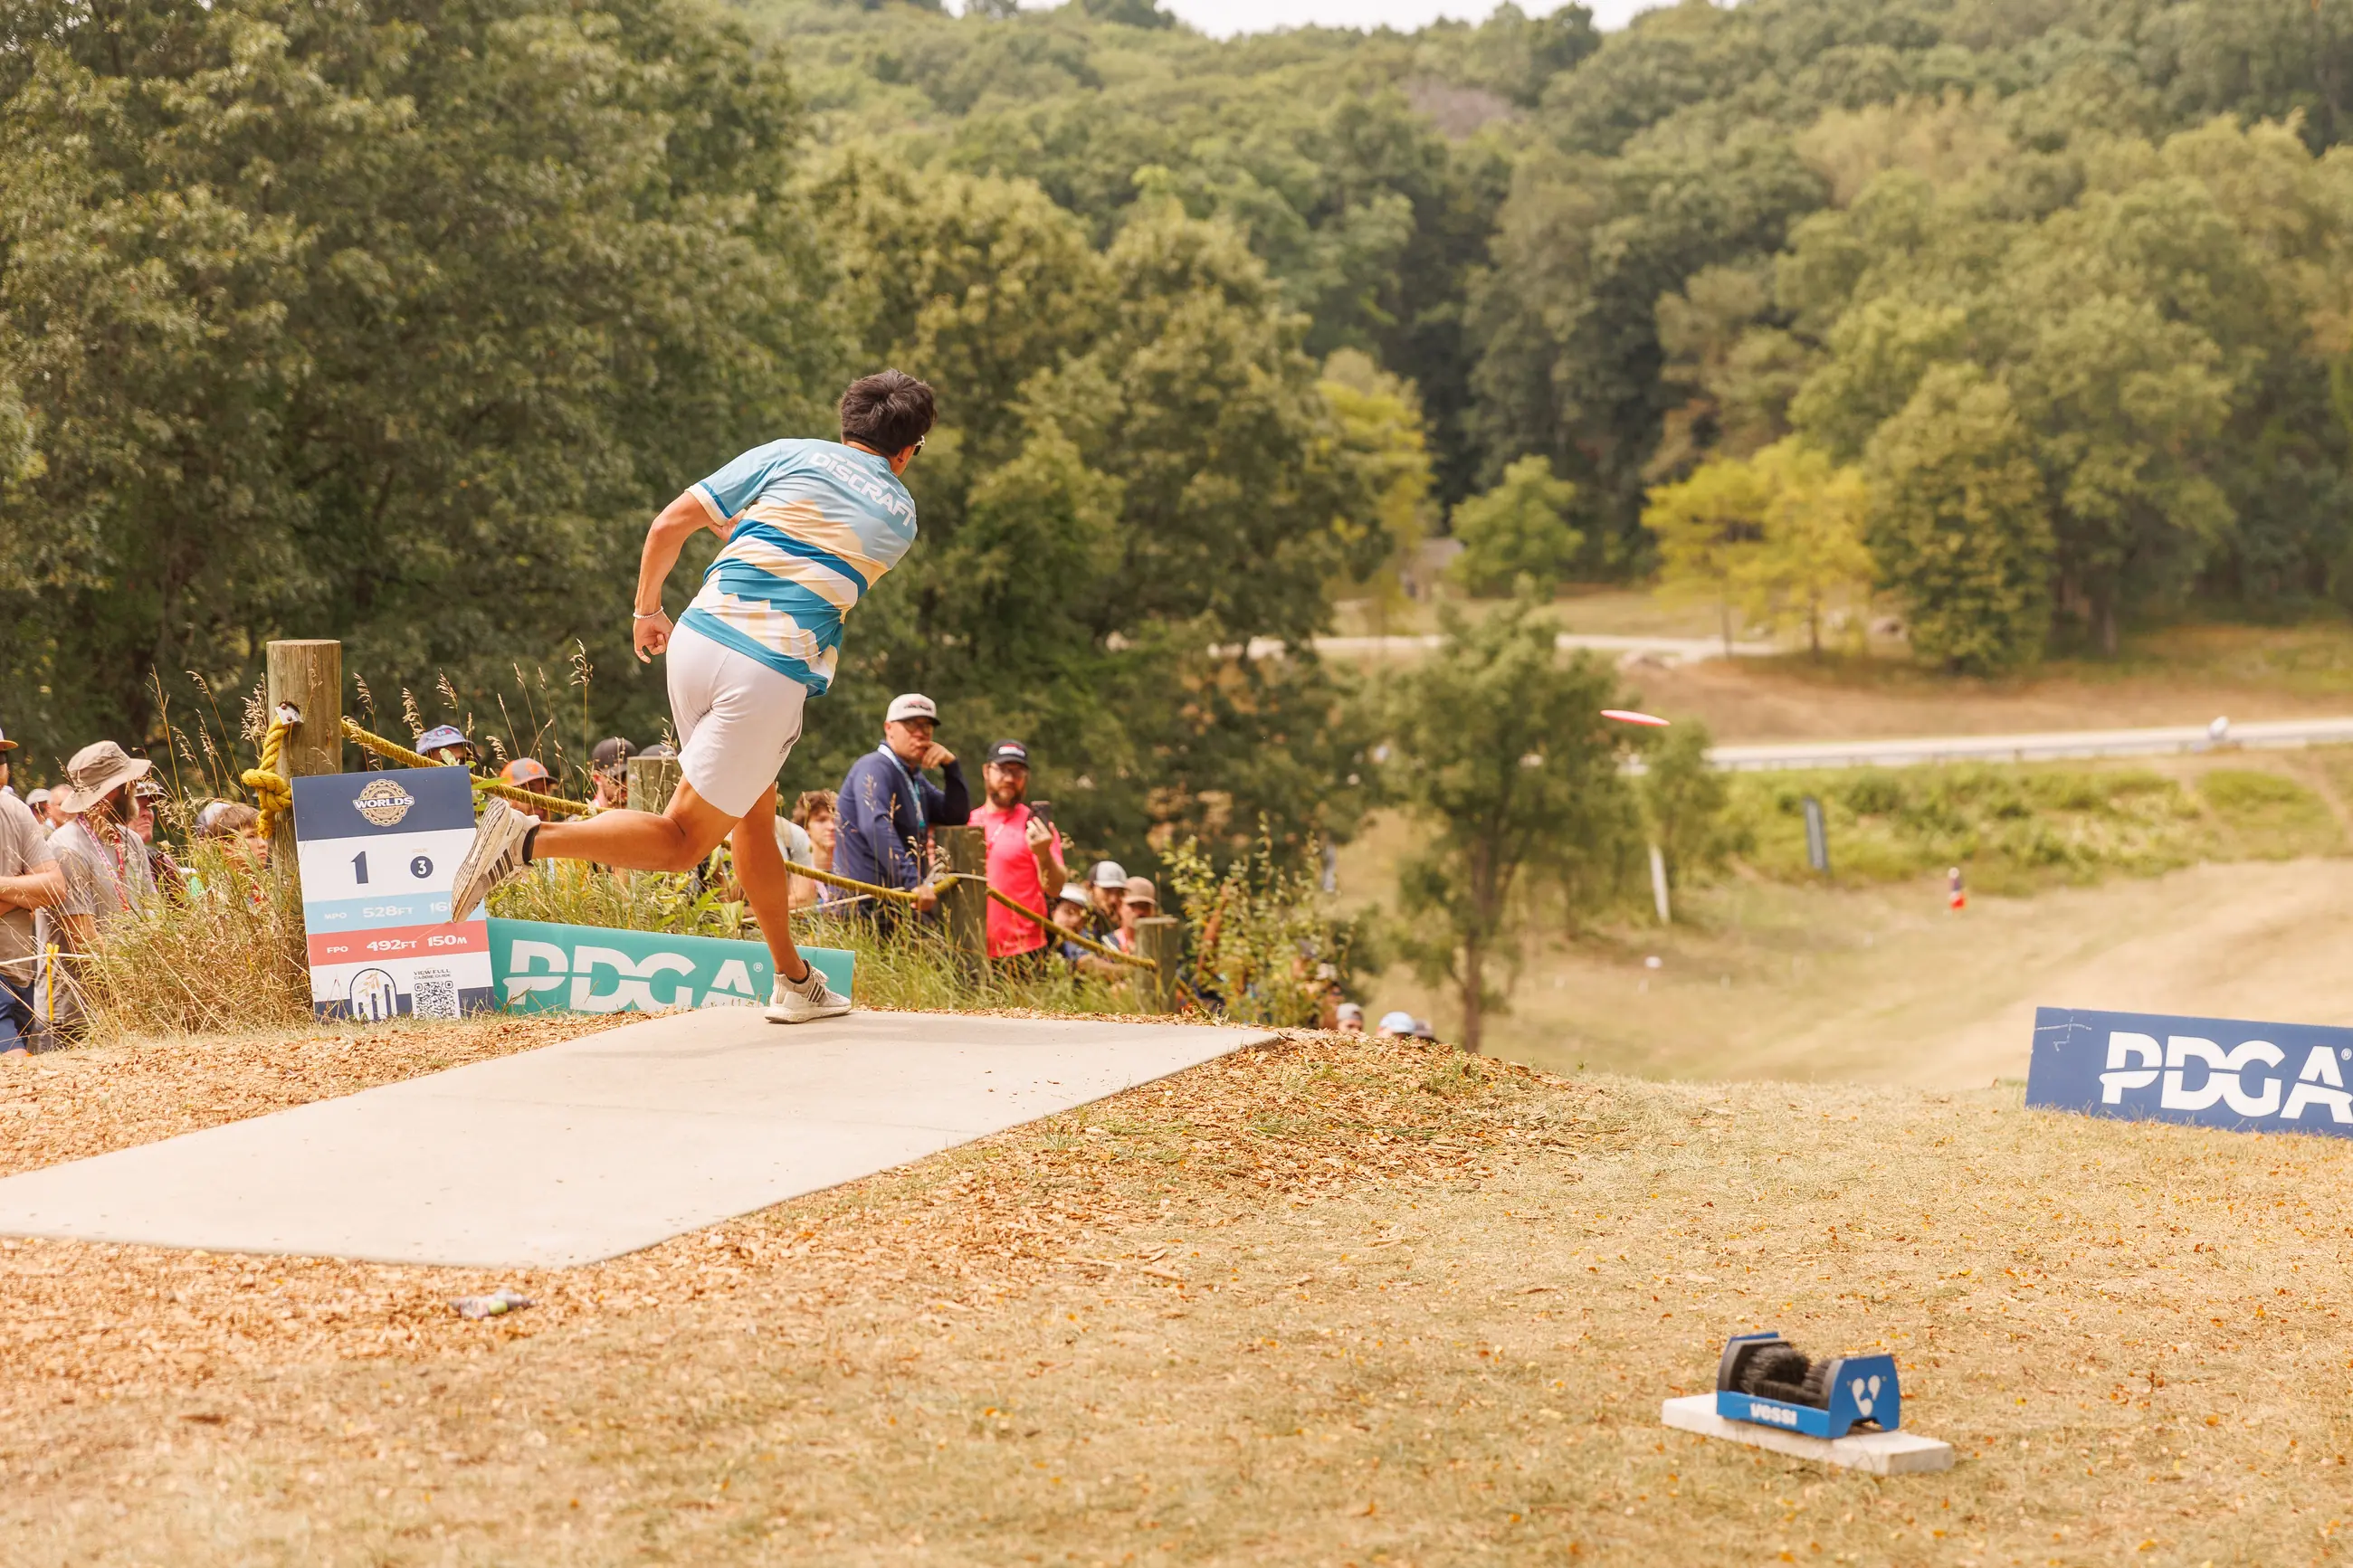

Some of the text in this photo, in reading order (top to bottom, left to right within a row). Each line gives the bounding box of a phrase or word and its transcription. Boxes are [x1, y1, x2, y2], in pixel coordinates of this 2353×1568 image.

[808, 451, 915, 527] DISCRAFT
[354, 796, 414, 809] WORLDS
[350, 851, 369, 885] 1
[417, 860, 427, 875] 3
[323, 911, 348, 920] MPO
[362, 906, 414, 918] 528FT
[326, 935, 468, 954] FPO 492FT 150M
